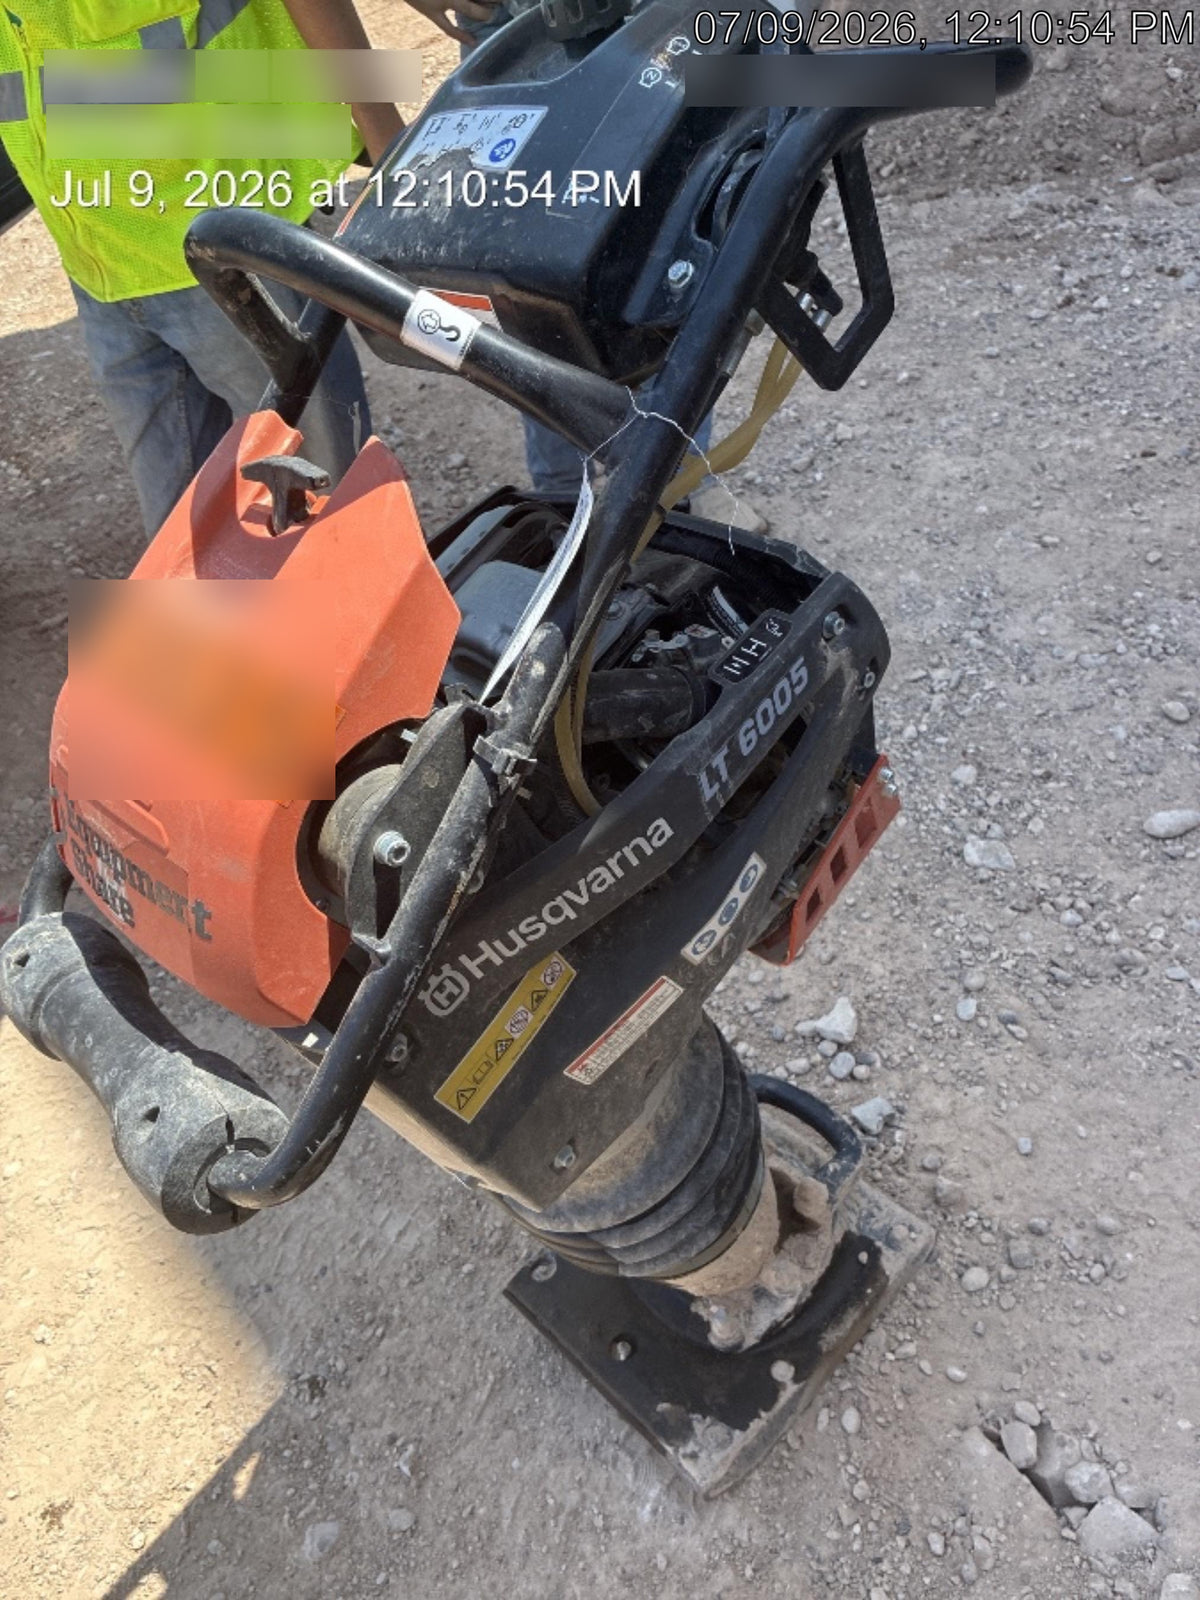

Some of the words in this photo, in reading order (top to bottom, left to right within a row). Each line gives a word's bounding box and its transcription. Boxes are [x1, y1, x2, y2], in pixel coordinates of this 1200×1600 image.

[699, 746, 731, 802] LT
[738, 656, 808, 757] 6005
[458, 817, 675, 980] Husqvarna
